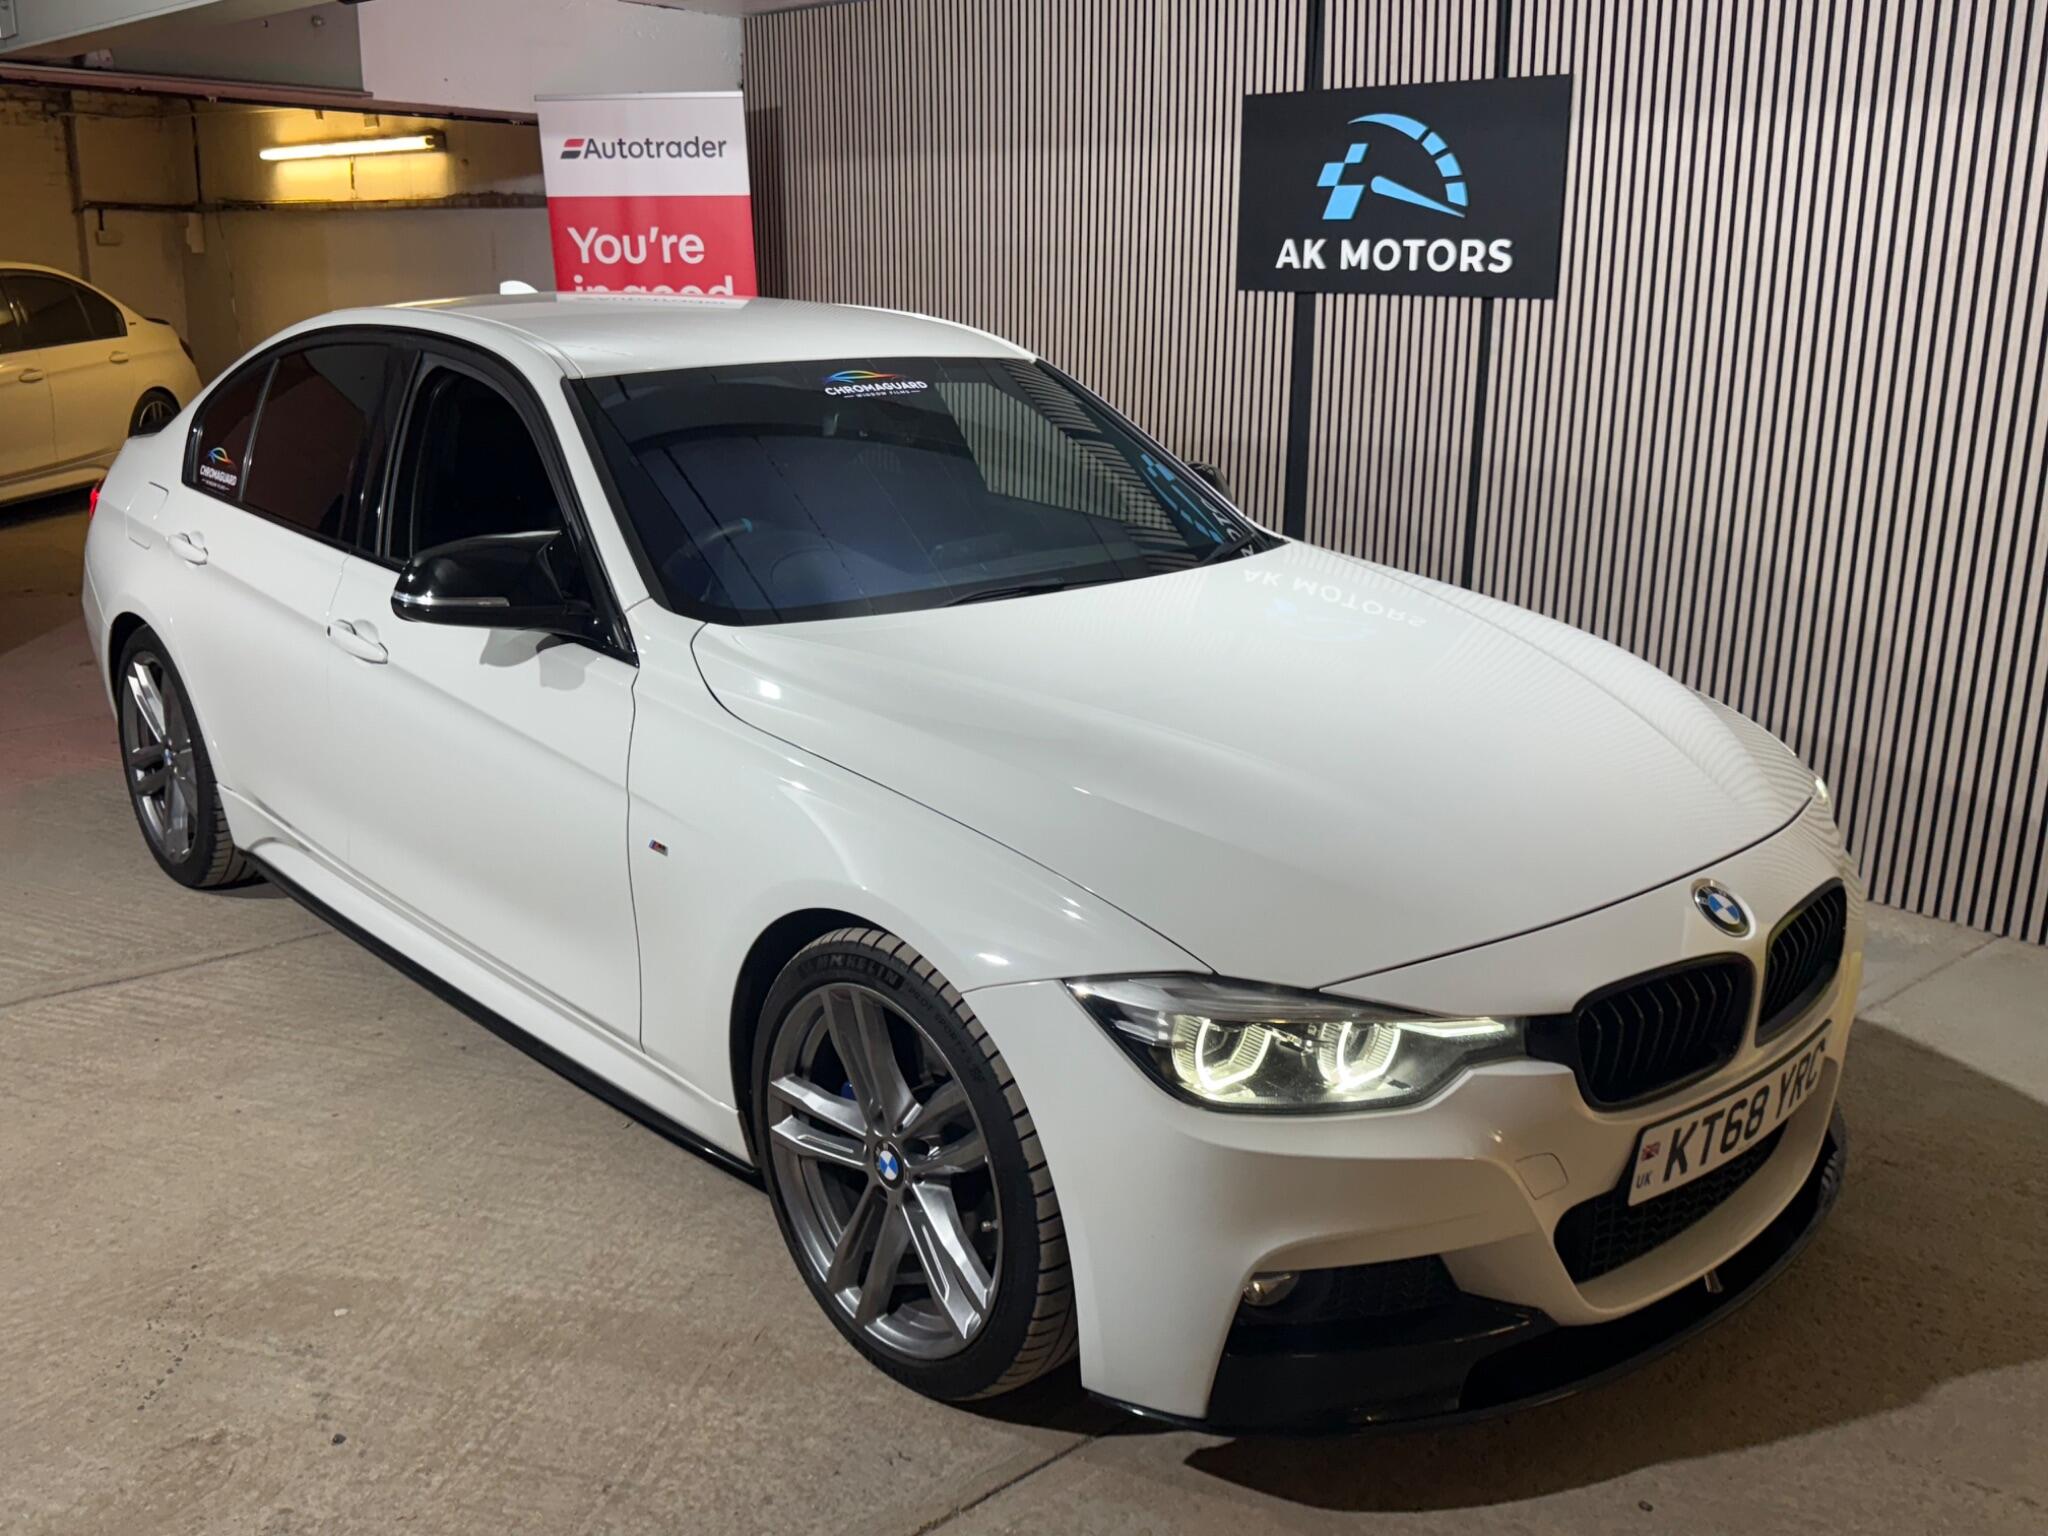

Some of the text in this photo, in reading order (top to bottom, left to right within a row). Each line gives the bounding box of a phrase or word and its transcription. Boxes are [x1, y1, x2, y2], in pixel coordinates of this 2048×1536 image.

[584, 136, 727, 159] Autotrader
[1275, 238, 1514, 274] AK MOTORS
[824, 380, 929, 396] CHROMAGUARD
[1663, 1037, 1826, 1183] KT68 YRC
[1636, 1171, 1653, 1189] UK
